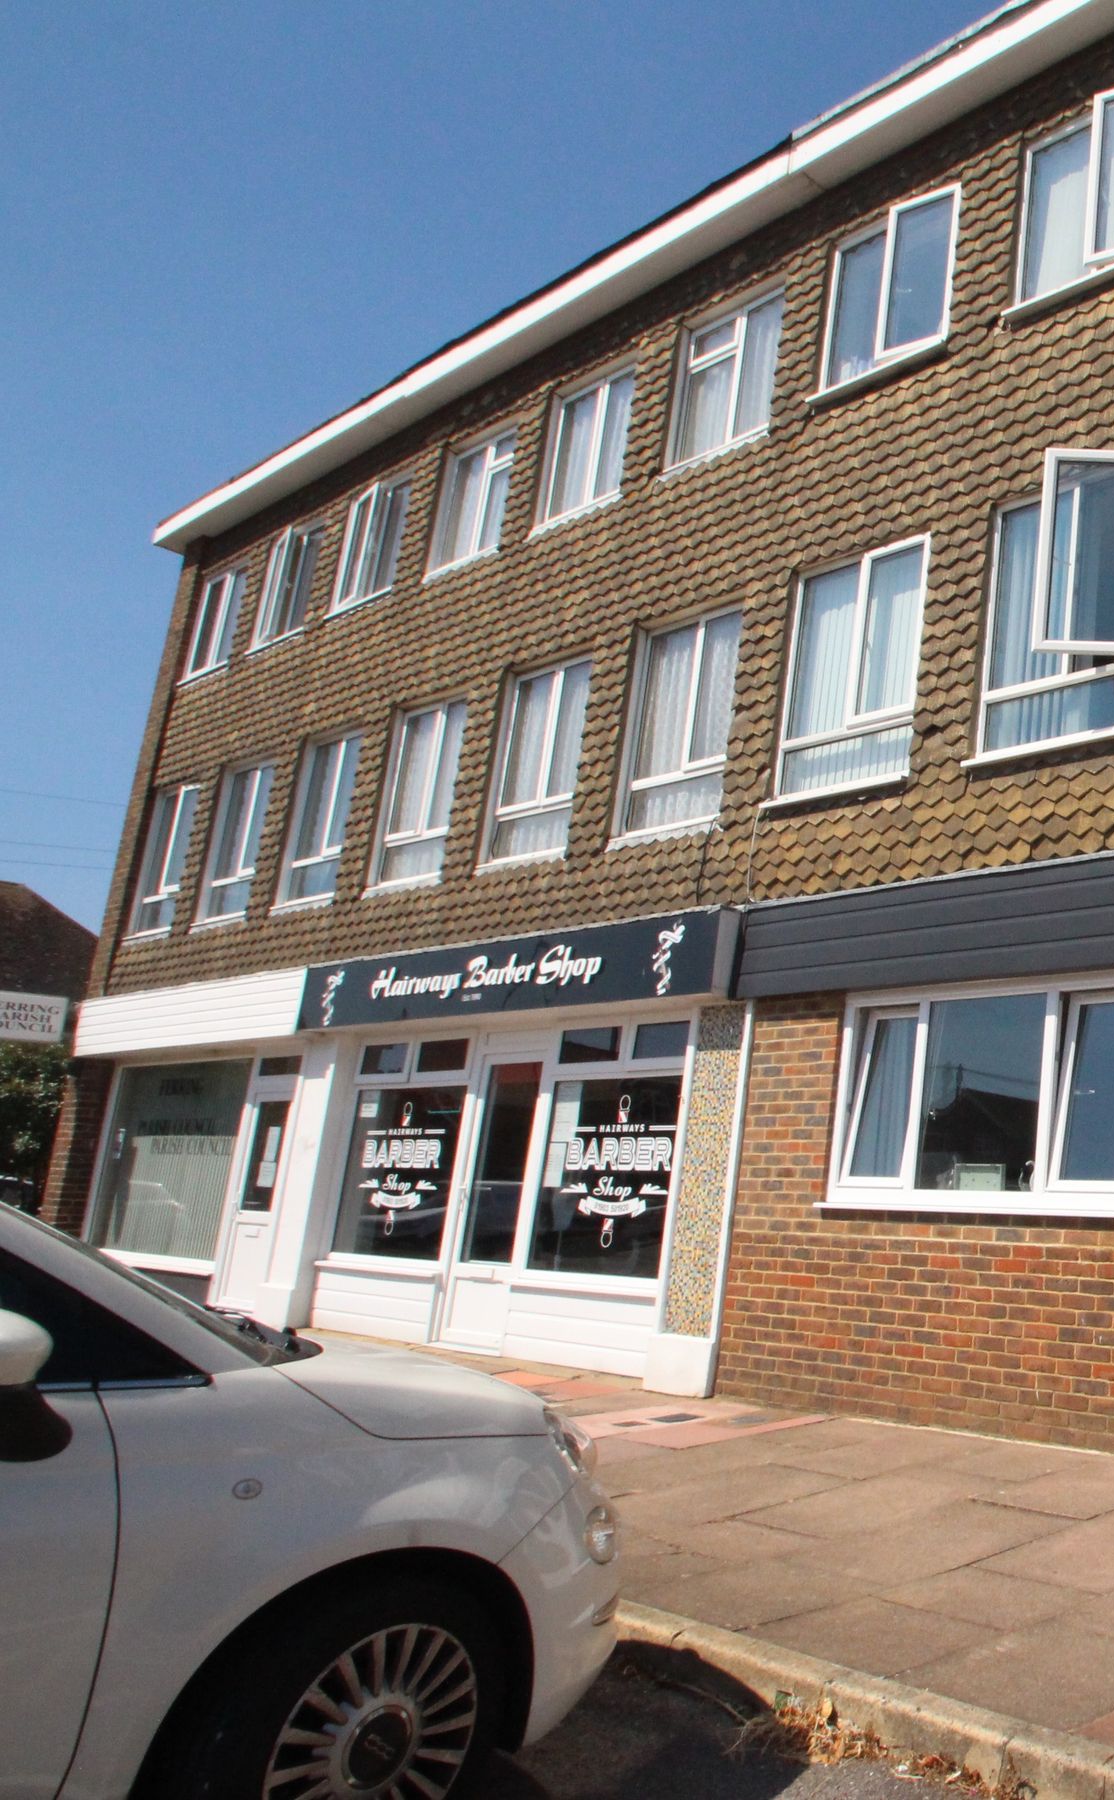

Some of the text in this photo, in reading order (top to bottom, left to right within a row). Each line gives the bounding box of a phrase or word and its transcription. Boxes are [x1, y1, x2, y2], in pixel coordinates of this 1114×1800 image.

[370, 944, 602, 999] Hairways Barber Shop
[388, 1128, 423, 1136] HAIRWAYS
[599, 1124, 645, 1133] HAIRWAYS
[361, 1138, 441, 1169] BARBER
[565, 1136, 673, 1171] BARBER
[382, 1173, 411, 1195] Shop
[592, 1176, 632, 1201] Shop
